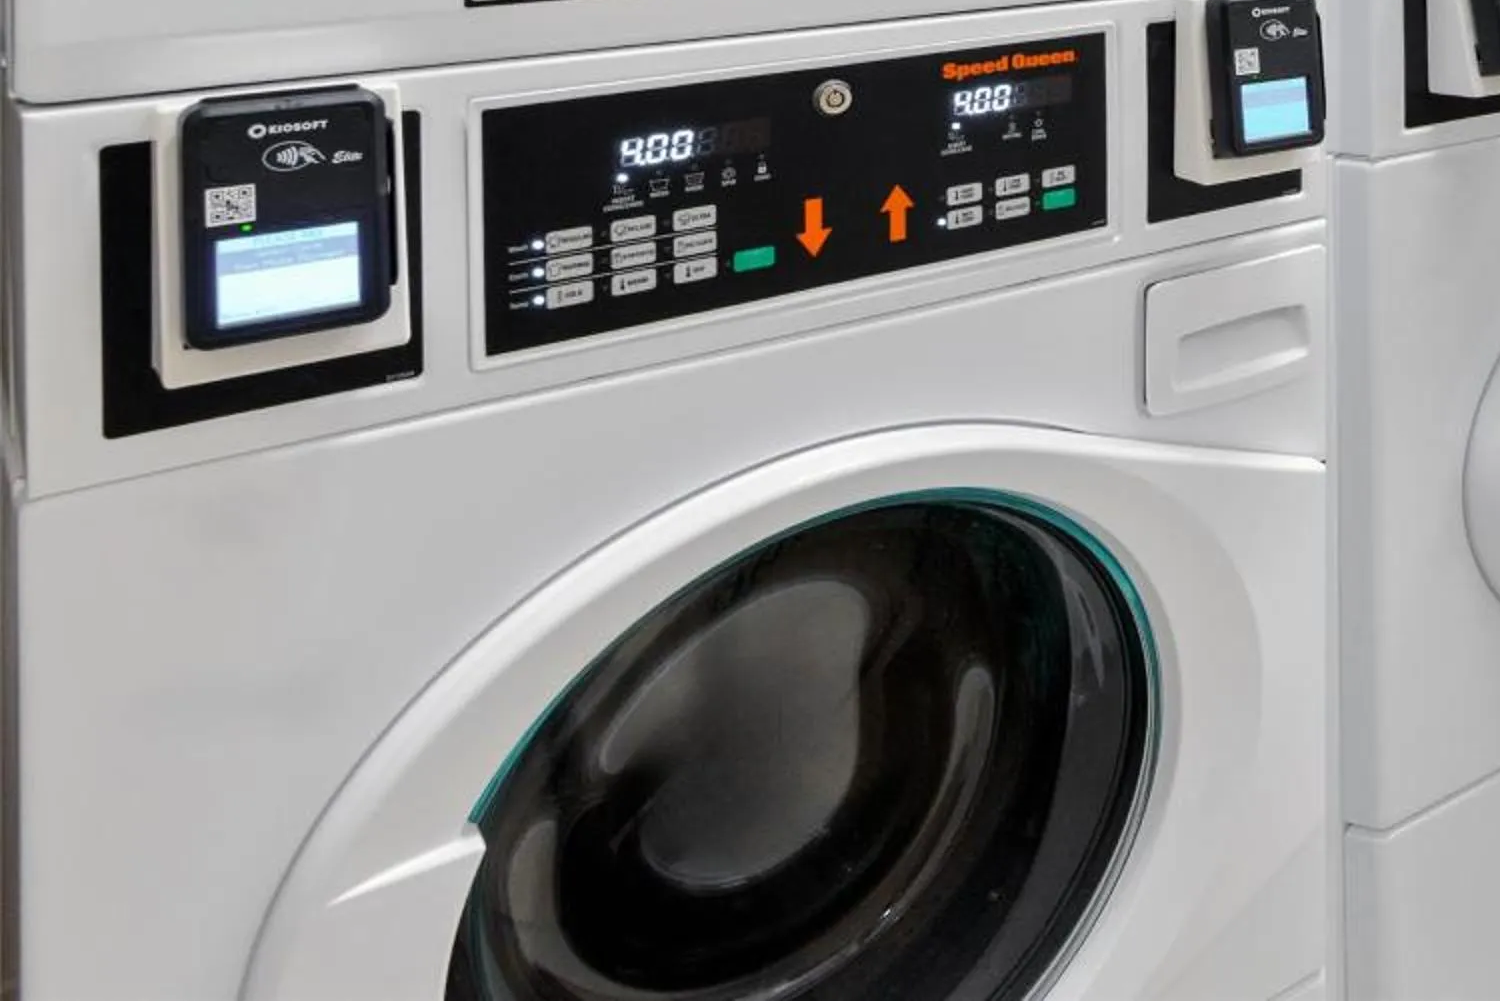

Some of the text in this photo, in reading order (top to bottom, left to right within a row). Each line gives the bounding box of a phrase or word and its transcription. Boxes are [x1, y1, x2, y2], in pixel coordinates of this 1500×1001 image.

[942, 49, 1076, 81] Speed Queen
[268, 119, 328, 135] KIOSOFT
[619, 128, 695, 167] 4.00
